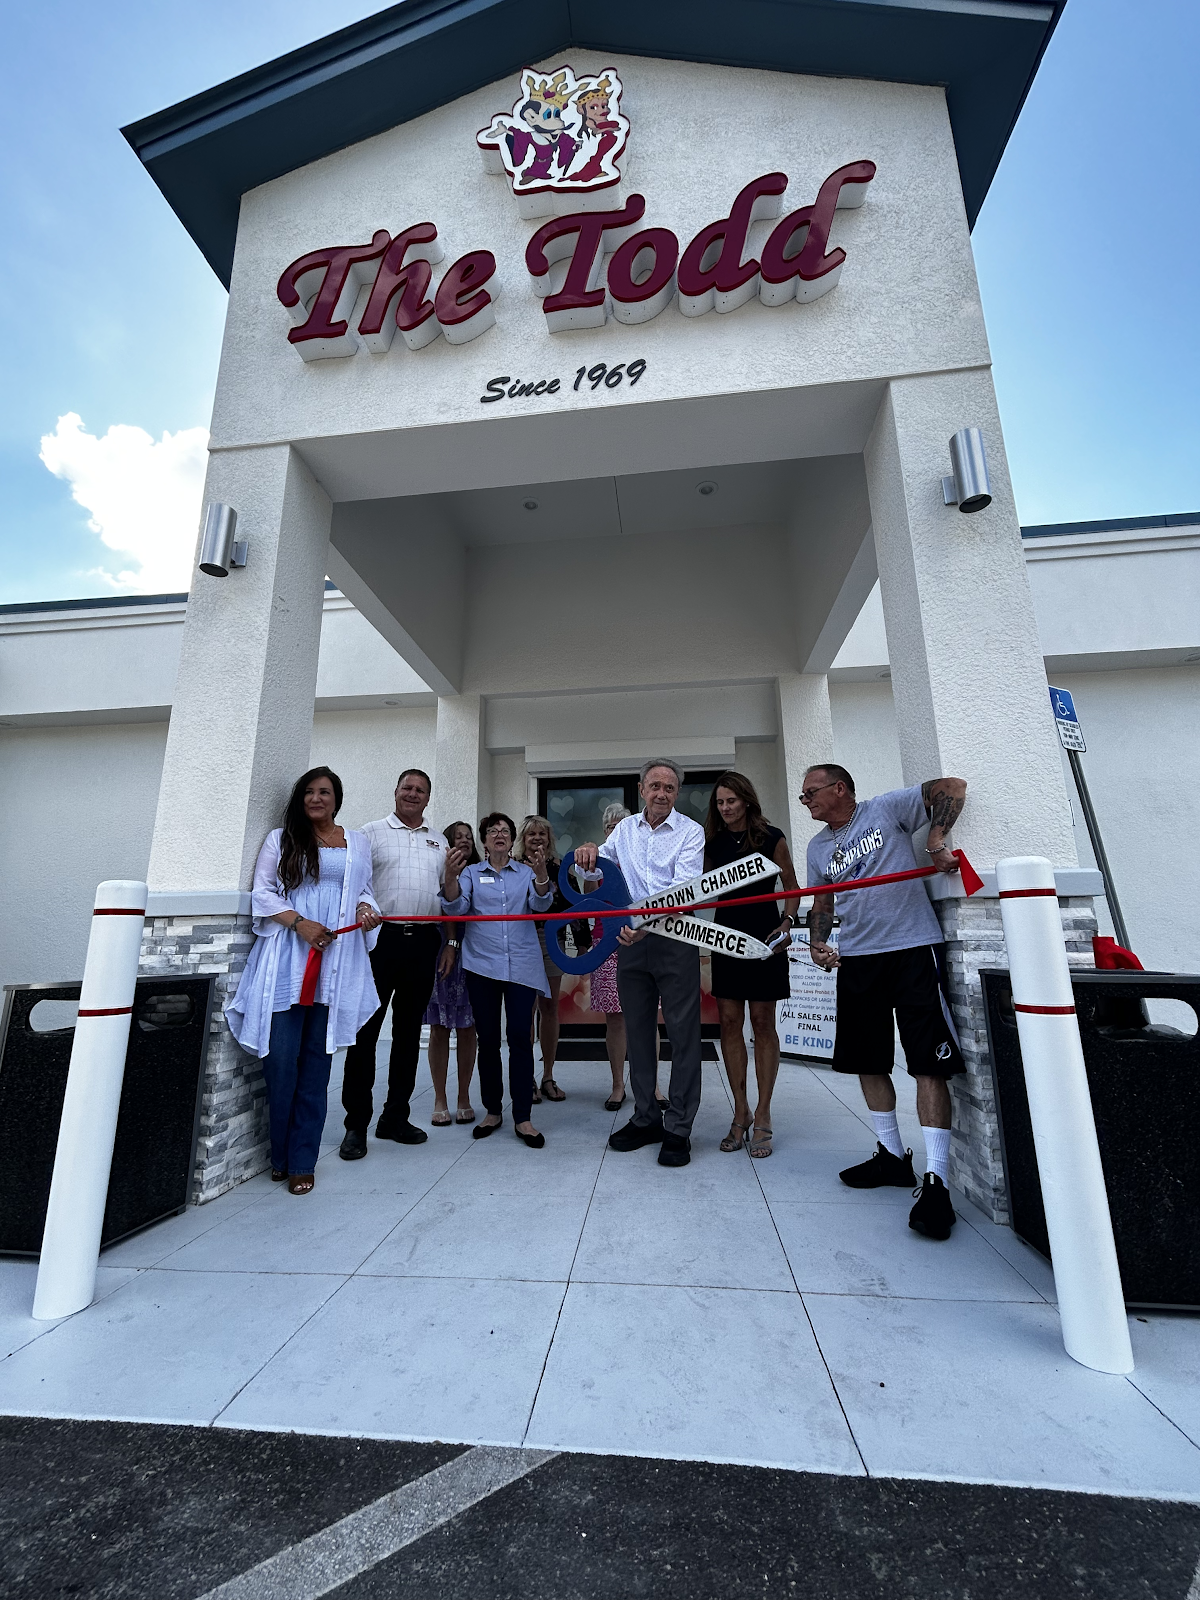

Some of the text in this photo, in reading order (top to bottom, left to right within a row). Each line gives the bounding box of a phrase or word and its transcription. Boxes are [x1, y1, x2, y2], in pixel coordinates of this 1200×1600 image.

[277, 159, 877, 345] The Todd
[480, 358, 647, 403] Since 1969
[700, 856, 766, 894] CHAMBER
[664, 916, 748, 955] COMMERCE
[782, 1011, 796, 1019] ALL
[797, 1012, 822, 1021] SALES
[797, 1022, 822, 1032] FINAL
[785, 1034, 834, 1049] BE KIND
